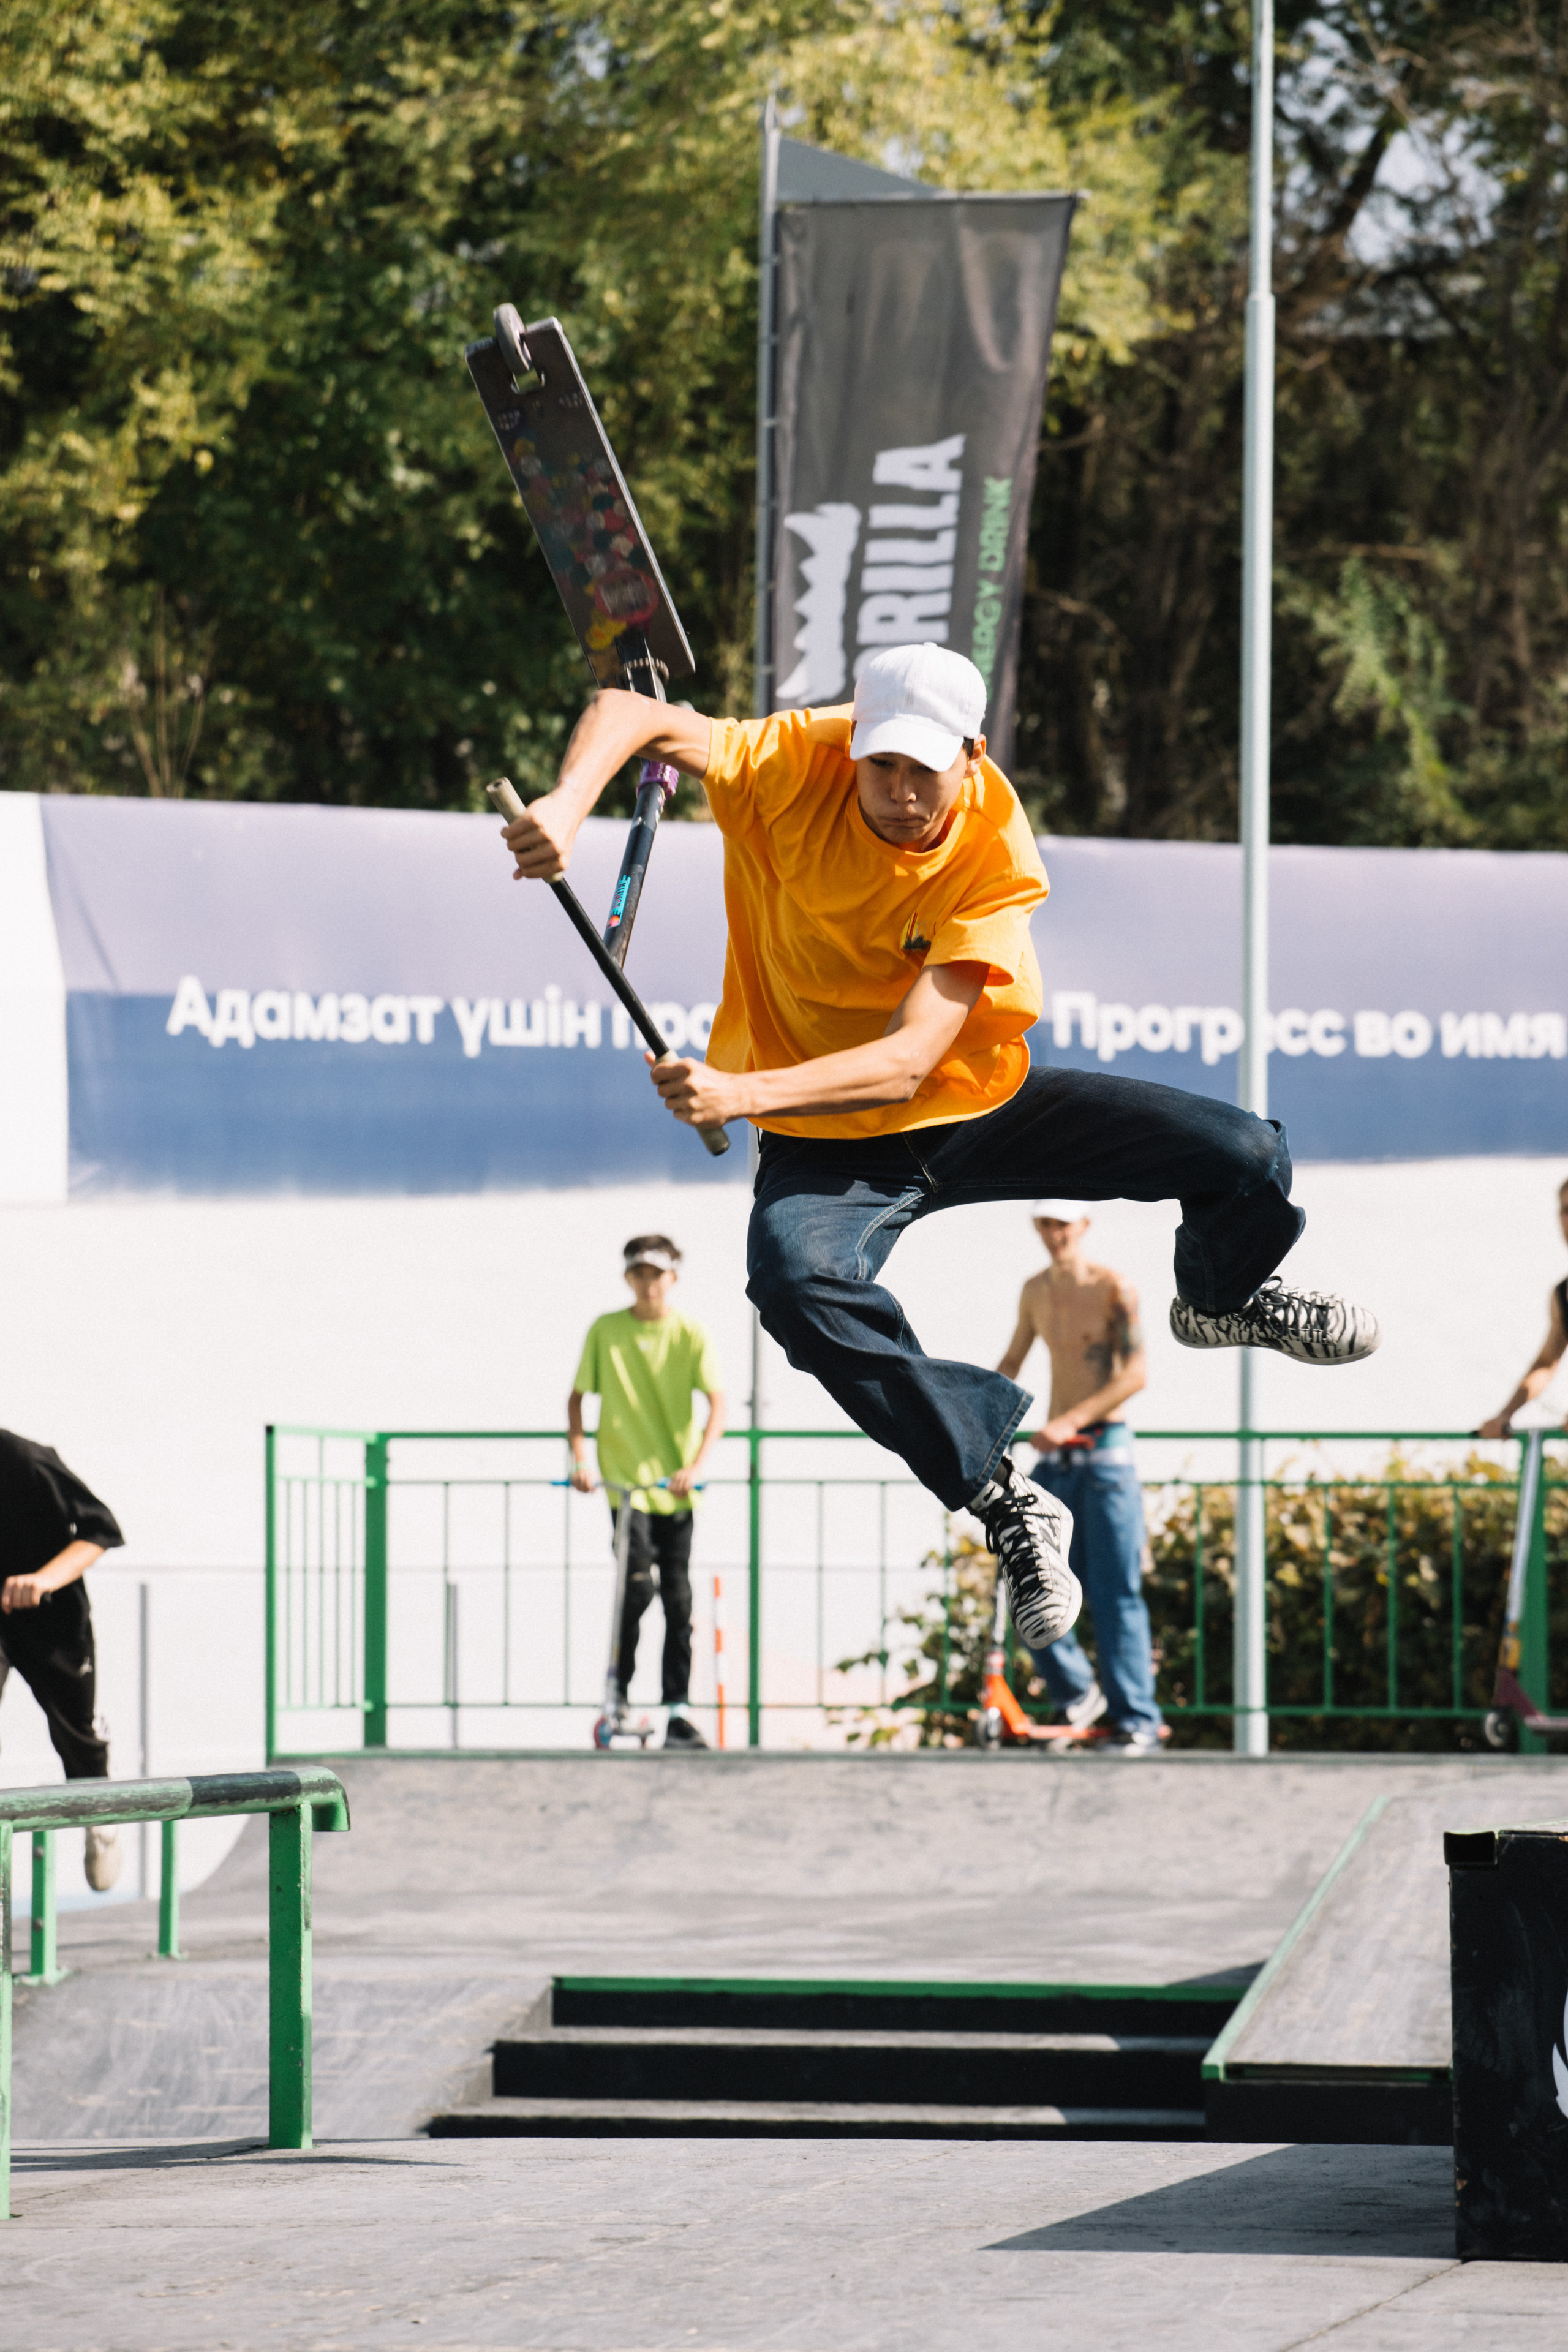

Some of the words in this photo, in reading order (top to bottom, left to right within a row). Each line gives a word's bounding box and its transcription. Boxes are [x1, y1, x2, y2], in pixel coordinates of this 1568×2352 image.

[854, 434, 967, 682] RILLA
[978, 475, 1012, 572] DRINK
[971, 578, 1003, 703] ERGY
[166, 976, 444, 1049] Адамзат
[452, 984, 601, 1058] үшін
[1051, 990, 1348, 1066] Прогрсс
[1354, 1009, 1434, 1059] во
[1439, 1011, 1567, 1060] имя
